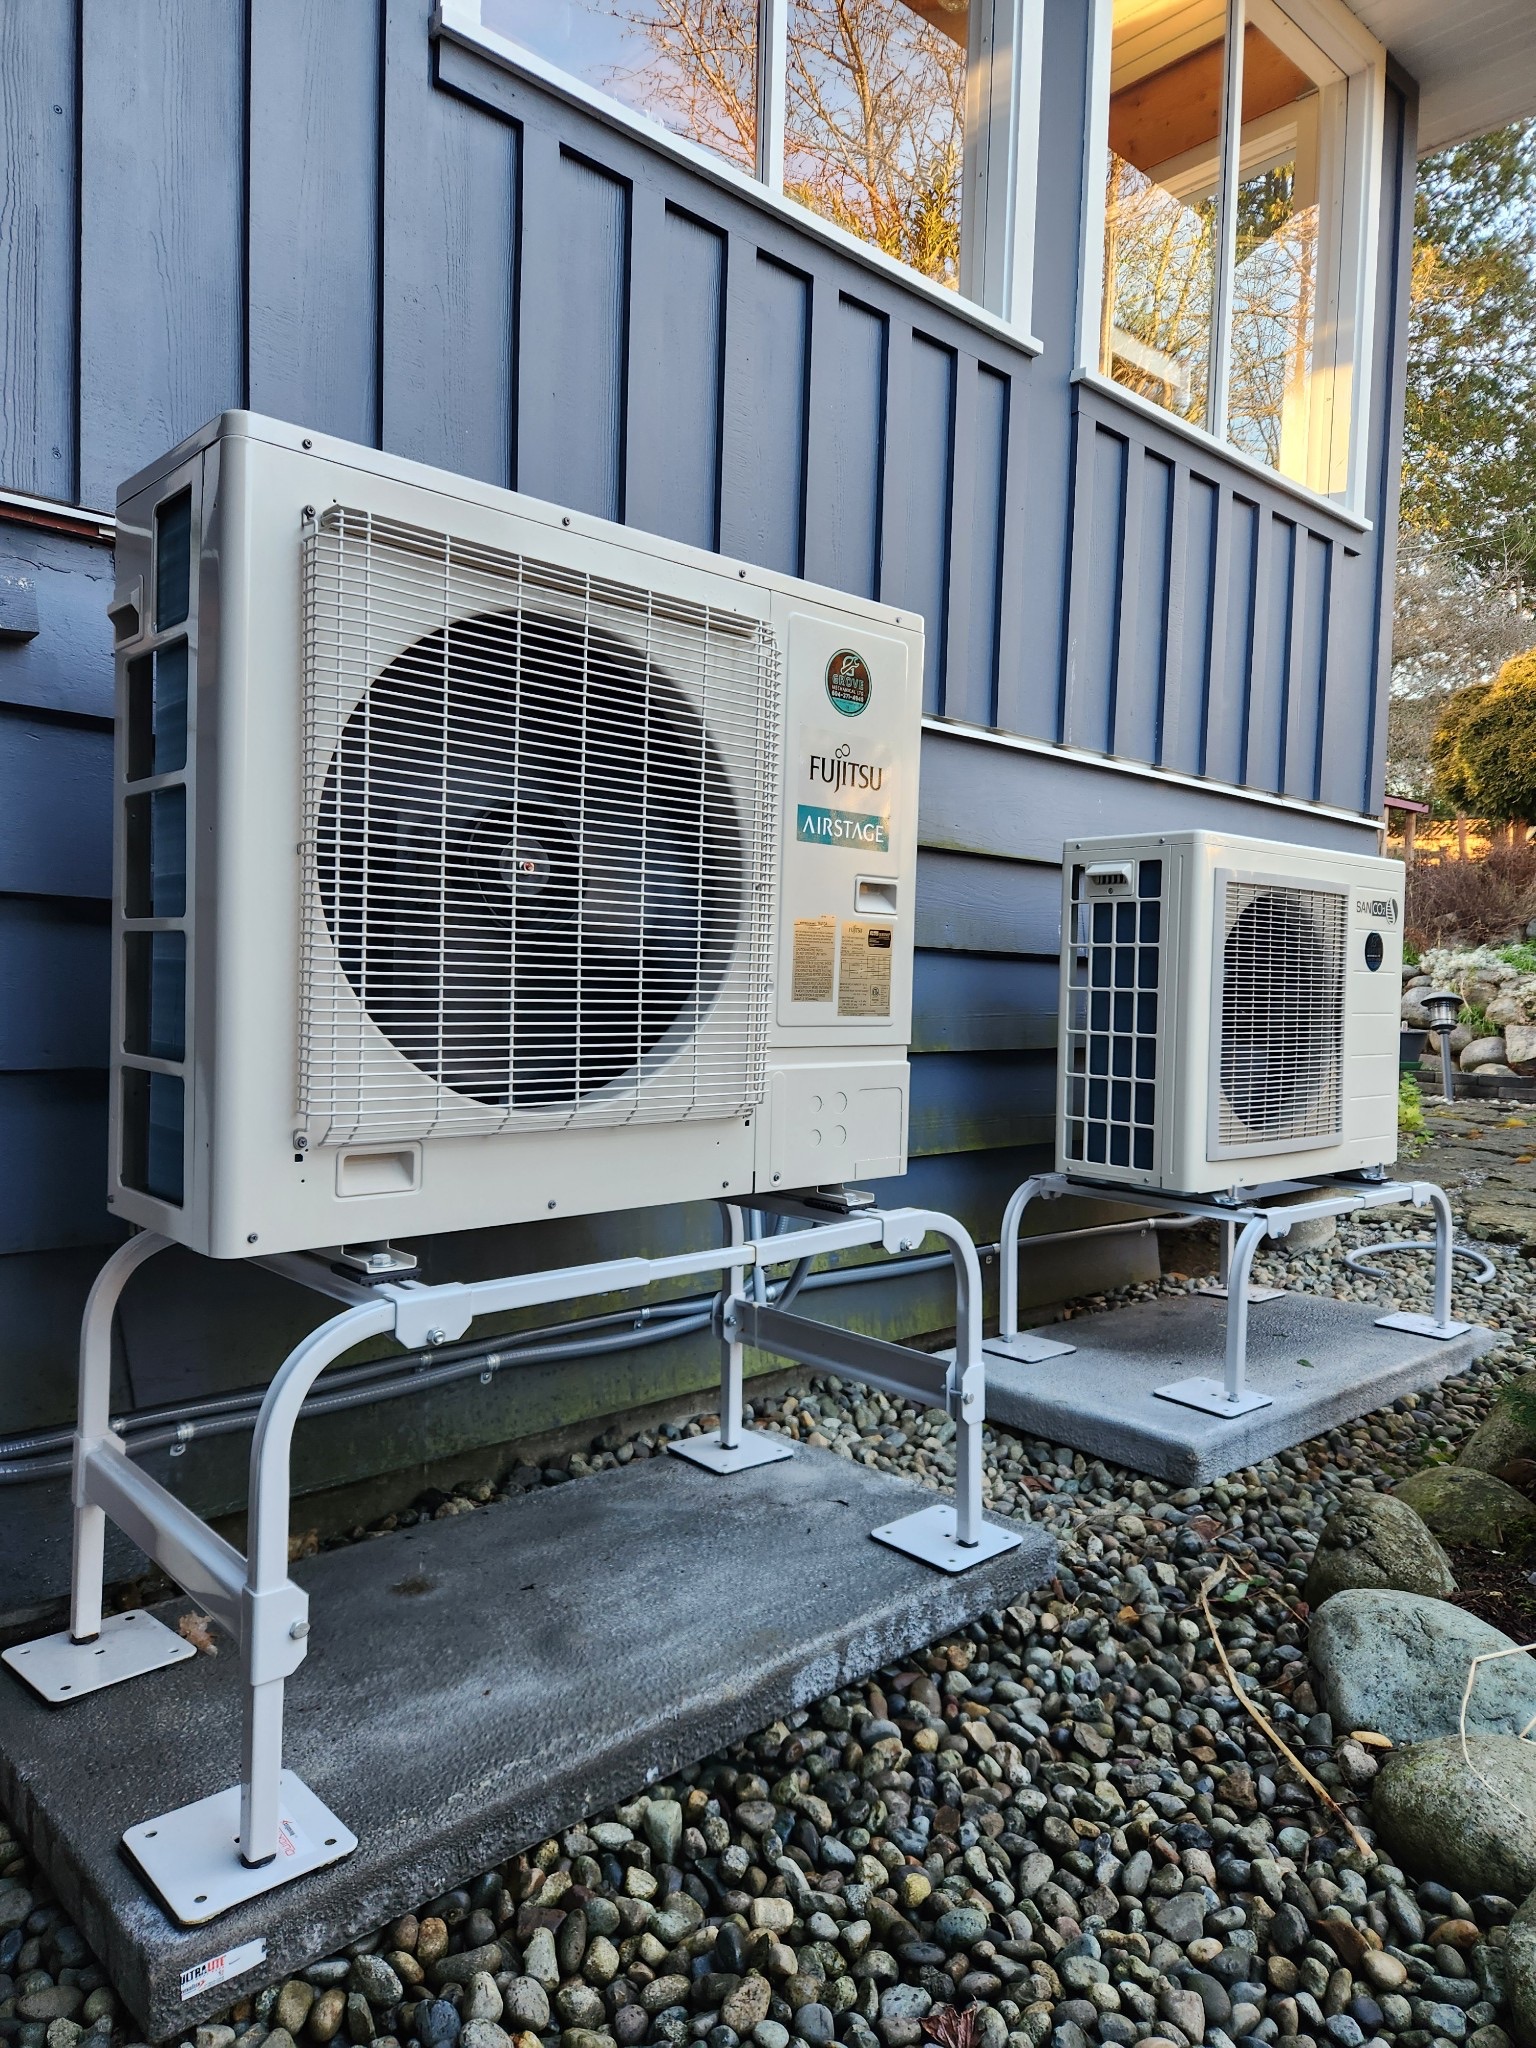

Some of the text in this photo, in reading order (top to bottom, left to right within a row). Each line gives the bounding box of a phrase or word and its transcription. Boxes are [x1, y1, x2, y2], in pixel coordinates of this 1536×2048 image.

[832, 674, 864, 690] GROVE
[809, 755, 883, 793] FUJITSU
[802, 815, 884, 843] AIRSTAGE
